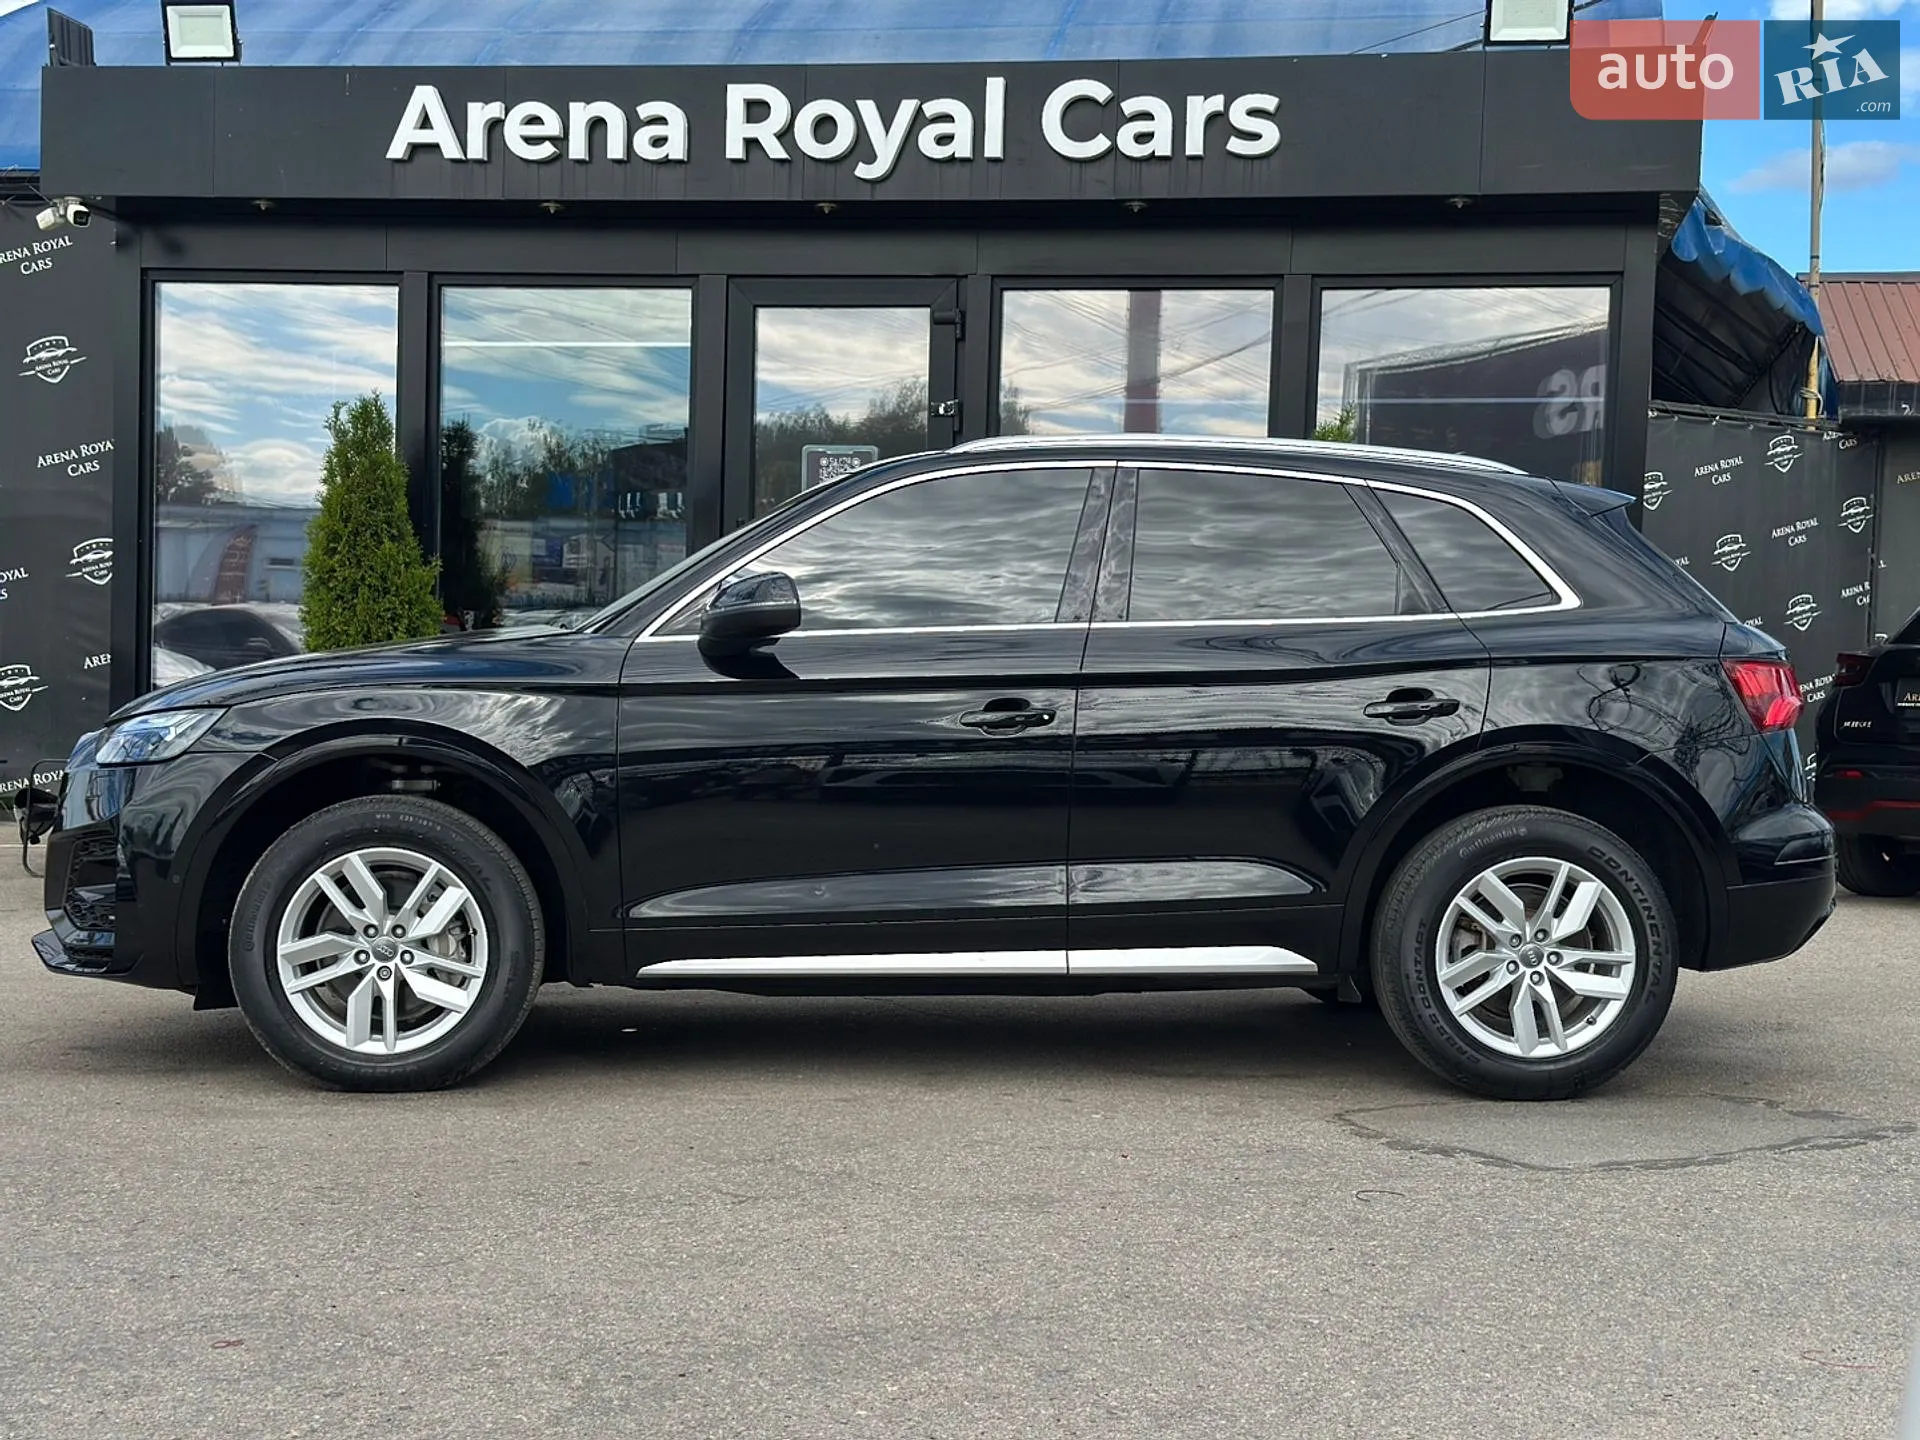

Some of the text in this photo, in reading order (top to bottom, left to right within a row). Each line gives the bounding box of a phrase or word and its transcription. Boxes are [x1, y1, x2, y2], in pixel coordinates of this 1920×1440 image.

[385, 76, 1281, 182] Arena Royal Cars
[32, 235, 73, 255] ROYAL
[20, 257, 53, 275] CARS
[37, 439, 114, 468] ARENA ROYA
[68, 460, 100, 477] CARS
